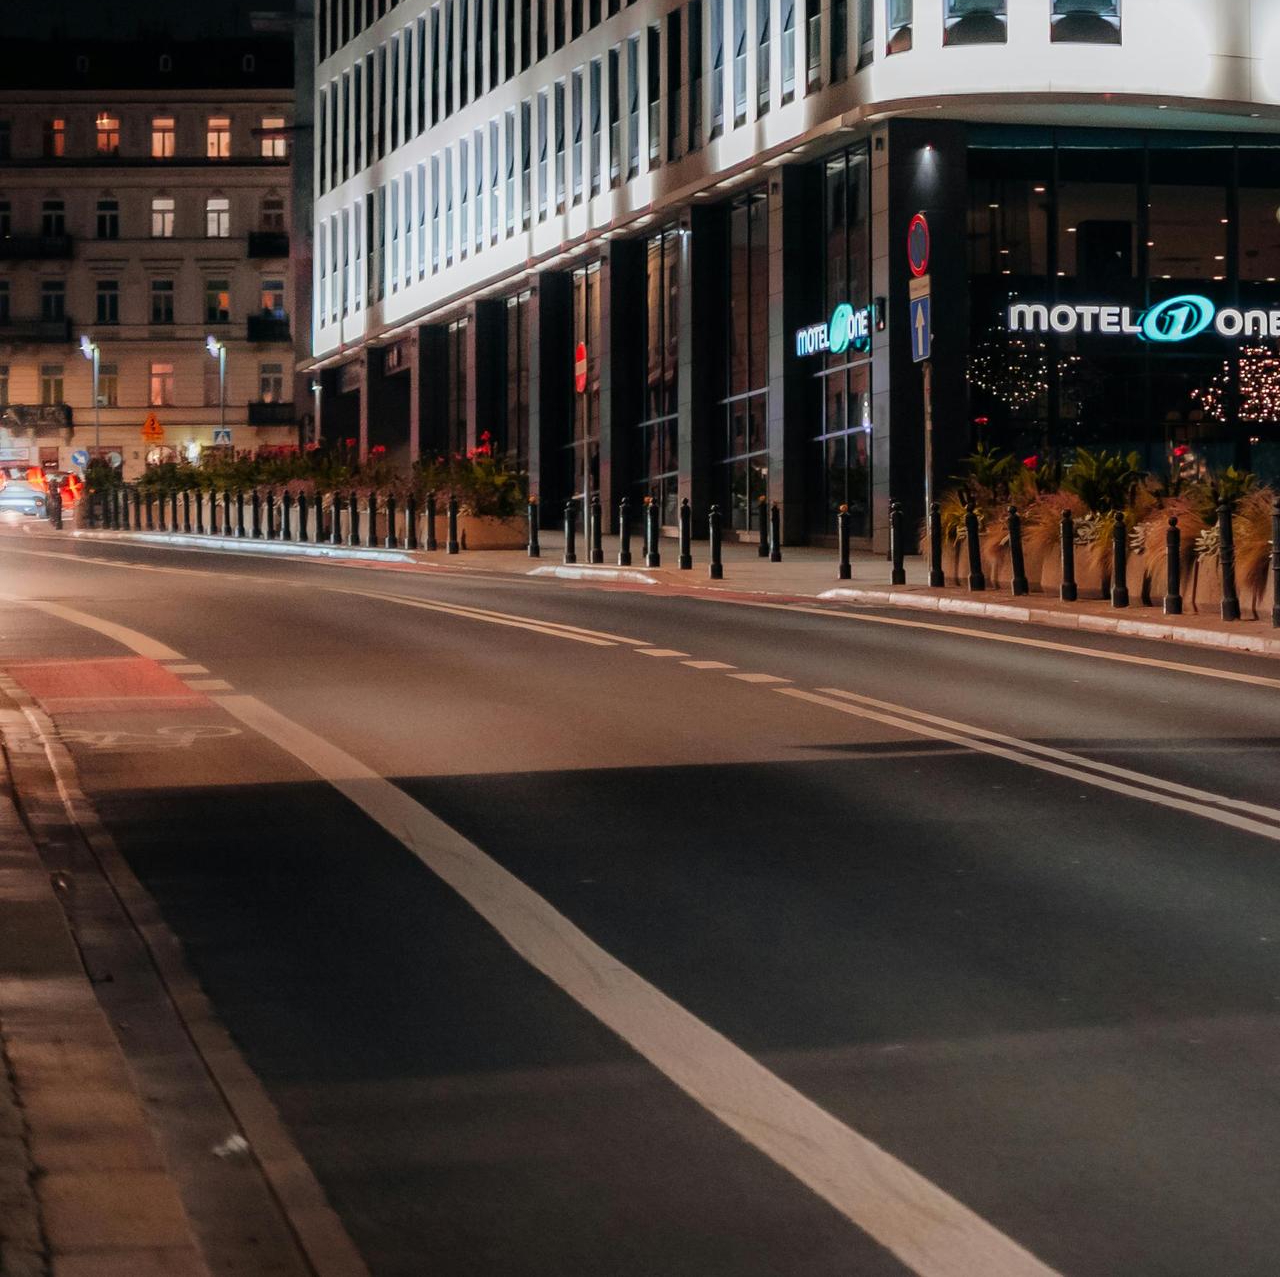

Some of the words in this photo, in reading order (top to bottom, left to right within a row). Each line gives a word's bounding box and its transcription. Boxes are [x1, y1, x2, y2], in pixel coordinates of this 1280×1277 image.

[796, 323, 830, 356] MOTEL
[847, 309, 869, 340] ONE
[1009, 303, 1143, 333] MOTEL
